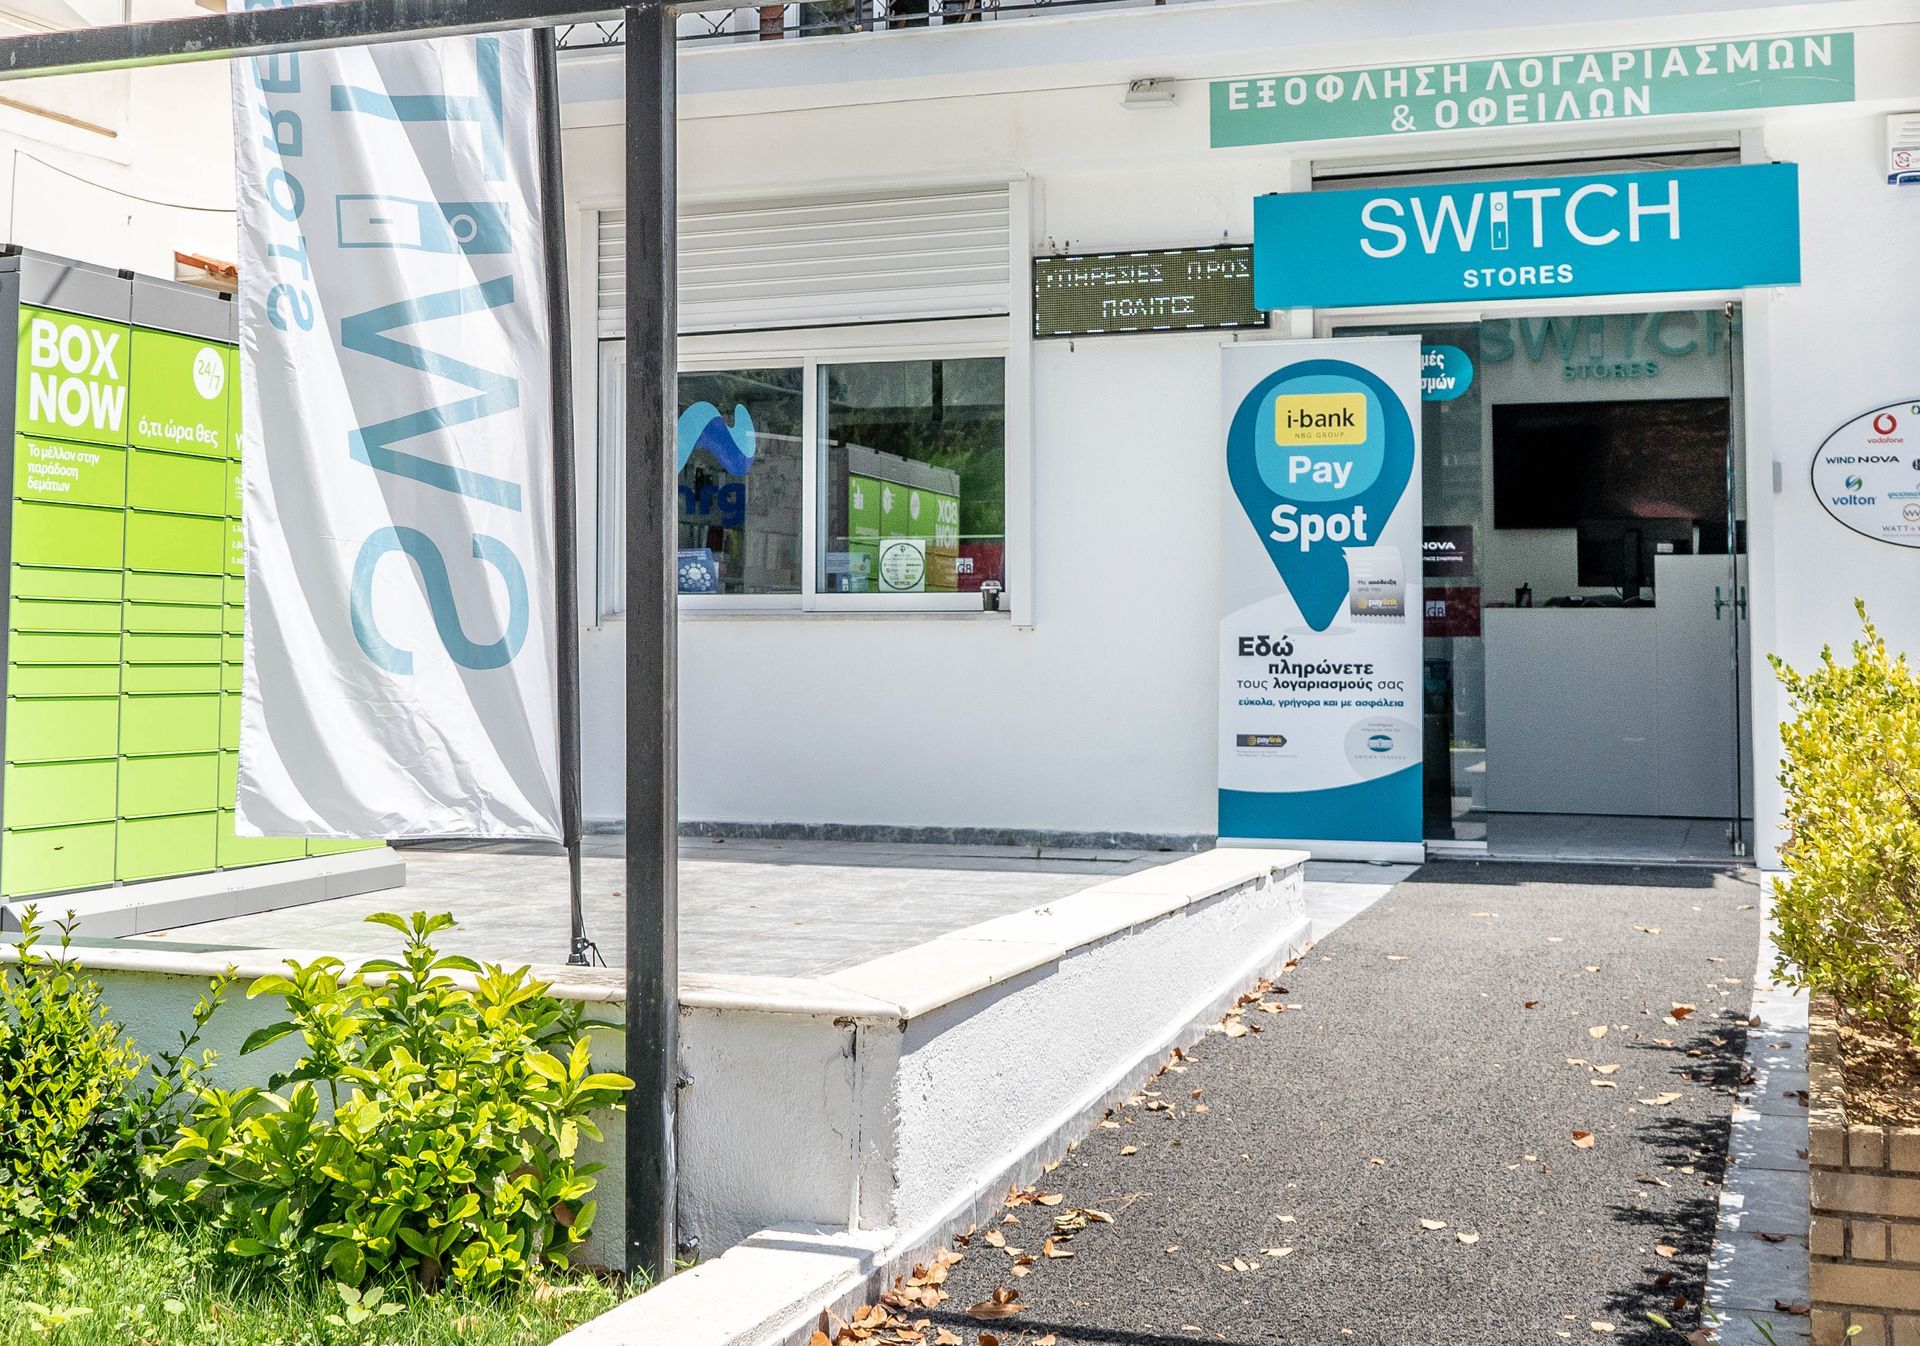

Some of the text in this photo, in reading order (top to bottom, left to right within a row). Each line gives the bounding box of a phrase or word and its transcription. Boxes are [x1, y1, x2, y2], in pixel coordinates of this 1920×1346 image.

[1228, 35, 1833, 110] ΕΞΟΦΛΗΣΗ ΛΟΓΑΡΙΑΣΜΩΝ
[1391, 85, 1650, 132] & ΟΦΕΙΛΩΝ
[1359, 180, 1681, 259] SWITCH
[1187, 259, 1250, 281] ΠΡΟΣ
[1462, 263, 1574, 289] STORES
[31, 318, 120, 380] BOX
[198, 360, 221, 393] 24/7
[1563, 360, 1658, 380] STORES
[29, 372, 126, 432] NOW
[1287, 407, 1355, 429] i-bank
[139, 416, 163, 439] ό,τι
[165, 419, 194, 444] ώρα
[196, 424, 218, 449] θες
[1316, 431, 1345, 439] GROUP
[27, 443, 101, 467] Το μέλλον στην
[1826, 455, 1900, 464] WIND NOVA
[27, 461, 79, 481] παράδοση
[1288, 455, 1353, 489] Pay
[27, 475, 71, 493] δεμάτων
[1832, 494, 1876, 505] volton
[1269, 504, 1368, 552] Spot
[1237, 634, 1294, 657] Εδώ
[1268, 659, 1374, 678] πληρώνετε
[1236, 677, 1405, 691] τους λογαριασμούς σας
[1238, 696, 1405, 708] εύκολα, γρήγορα και με ασφάλεια
